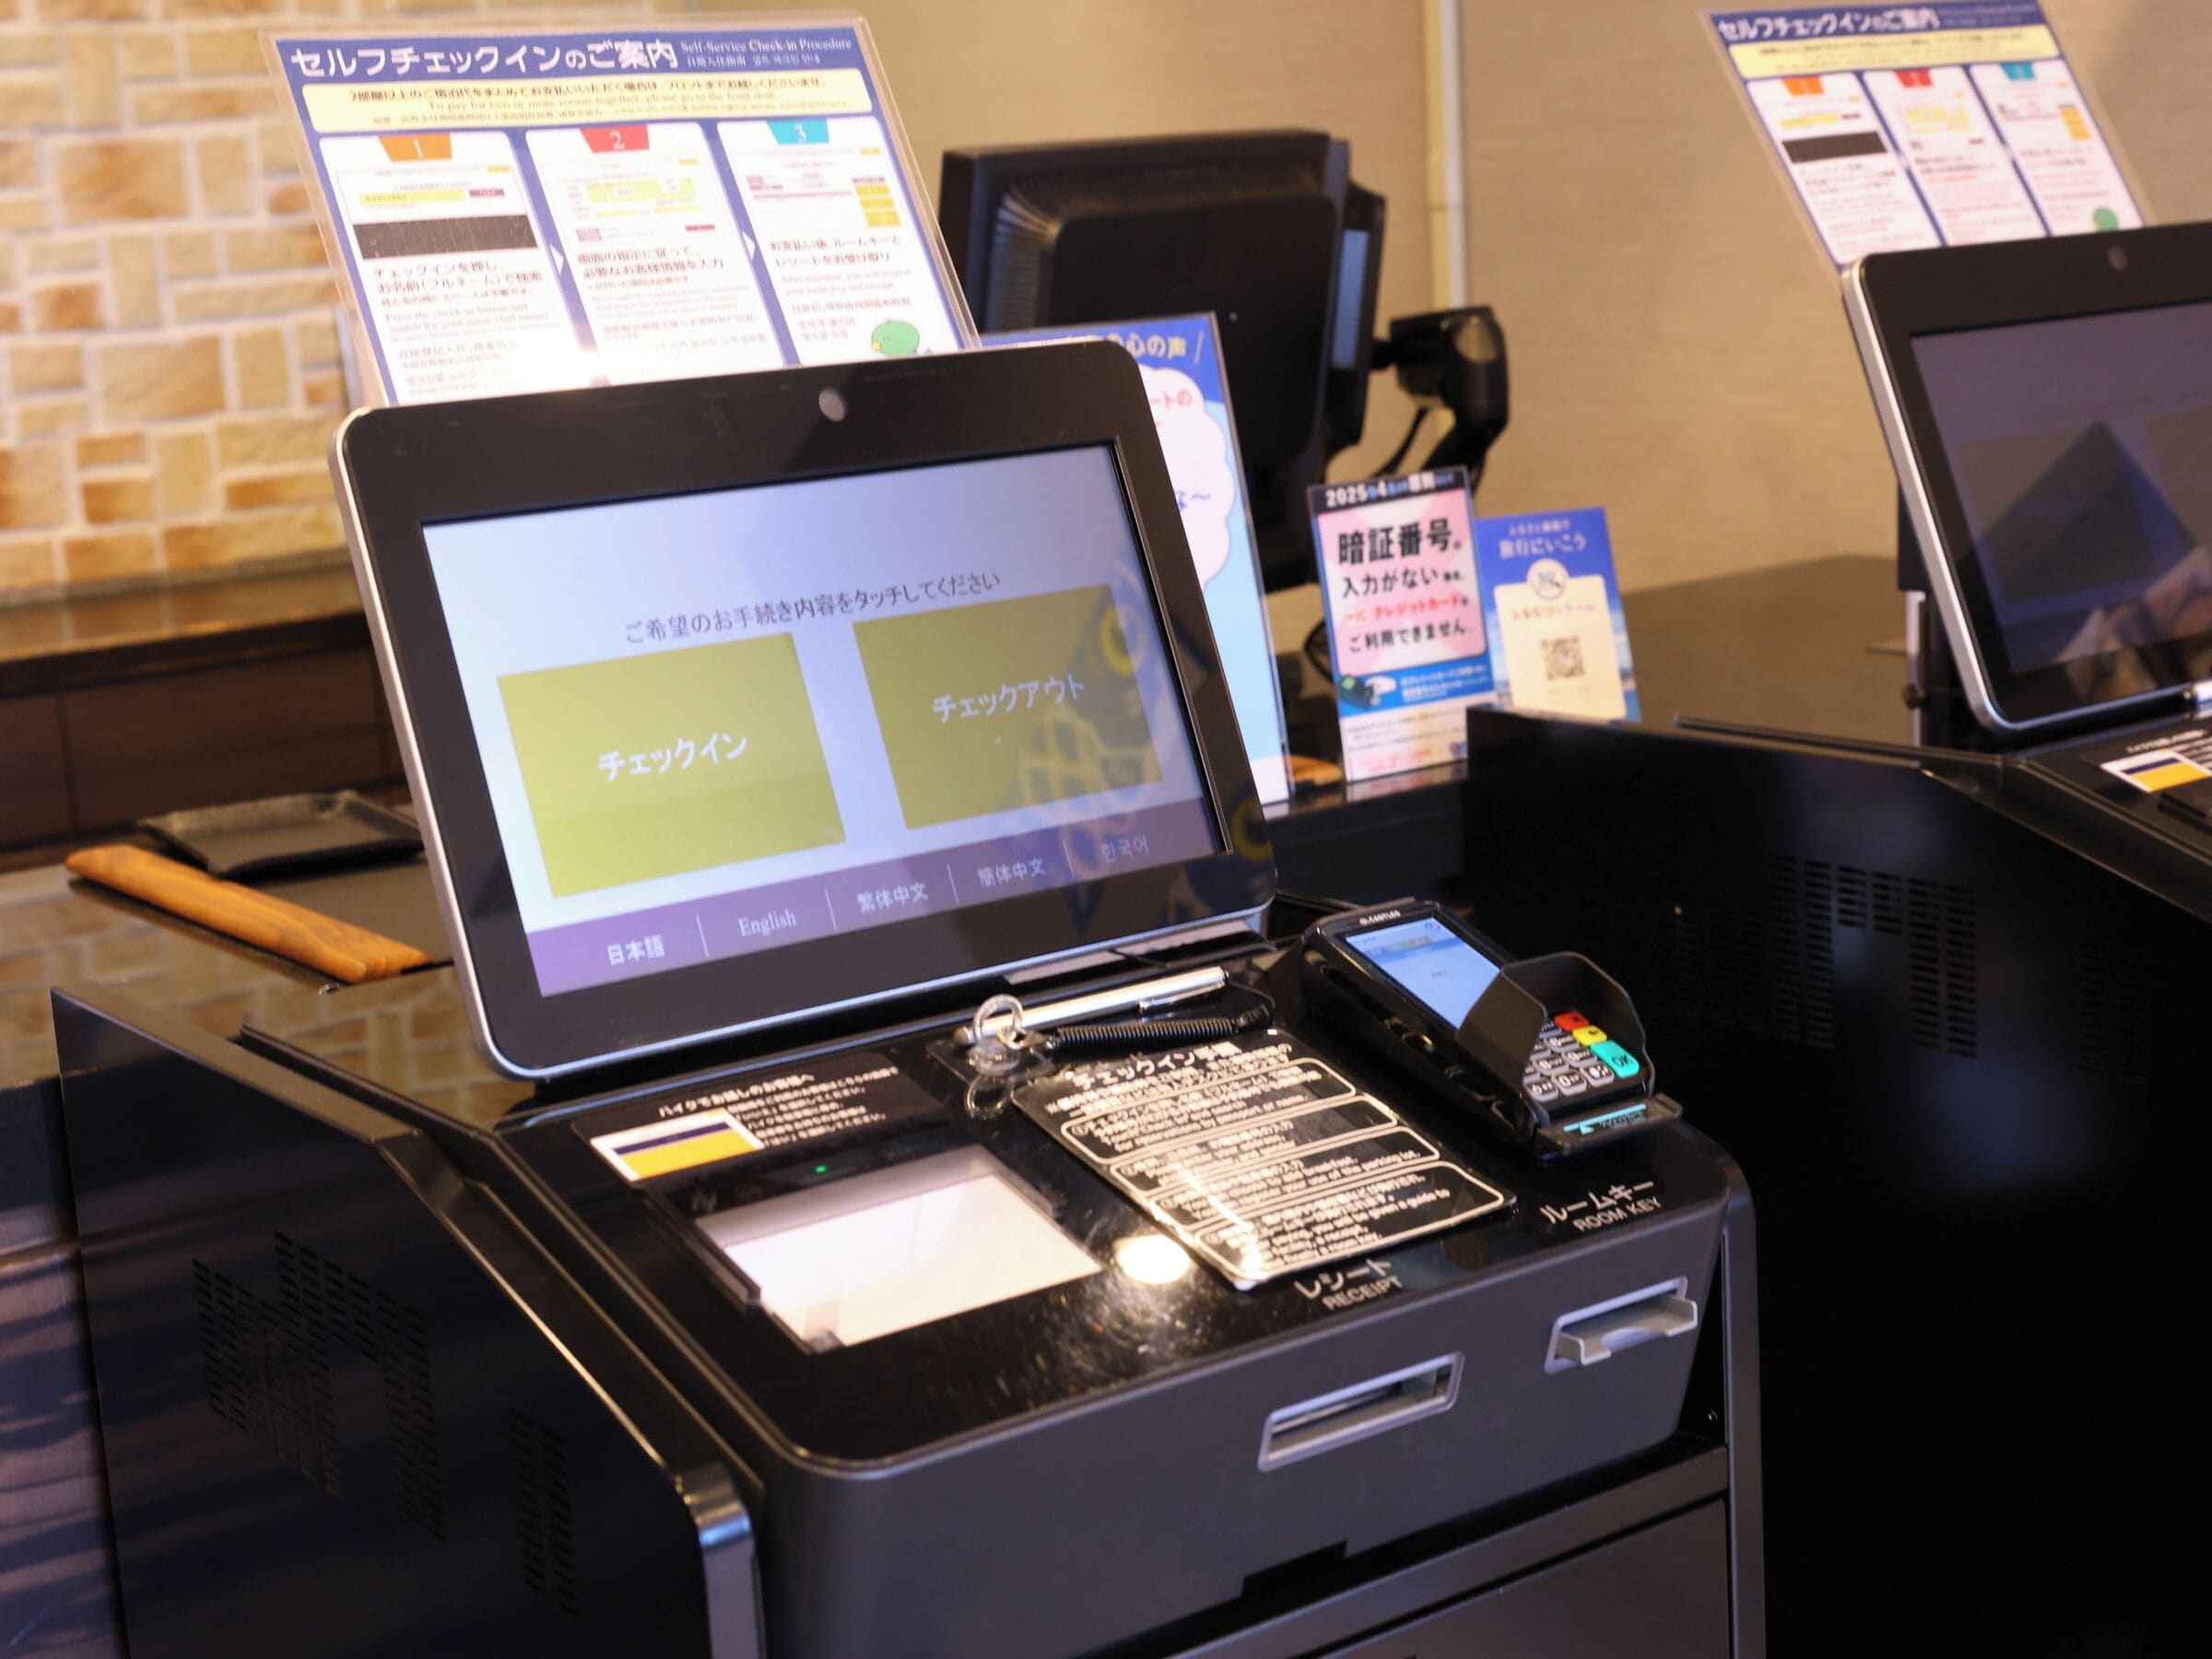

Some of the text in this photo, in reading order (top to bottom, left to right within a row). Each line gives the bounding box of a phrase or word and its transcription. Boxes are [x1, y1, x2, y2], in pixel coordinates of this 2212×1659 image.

[1717, 7, 1941, 41] セルフチェックインのご案内
[291, 39, 679, 78] セルフチェックインのご案内
[681, 37, 853, 53] Self-Service Check-in Procedure
[413, 139, 424, 159] 1
[609, 129, 625, 150] 2
[794, 123, 807, 144] 3
[625, 571, 1002, 643] ご希望のお手続き内容をタッチしてください
[932, 673, 1085, 724] チェックアウト
[597, 732, 747, 782] チェックイン
[1100, 833, 1150, 864] 한국어
[977, 856, 1047, 888] 簡体中文
[857, 881, 928, 915] 繁体中文
[738, 910, 797, 937] English
[606, 935, 665, 967] 日本語
[1611, 1053, 1630, 1067] OK
[1539, 1180, 1654, 1225] ルームキー
[1572, 1195, 1661, 1232] ROOM KEY
[1293, 1258, 1392, 1300] レシート
[1322, 1275, 1404, 1311] RECEIPT
